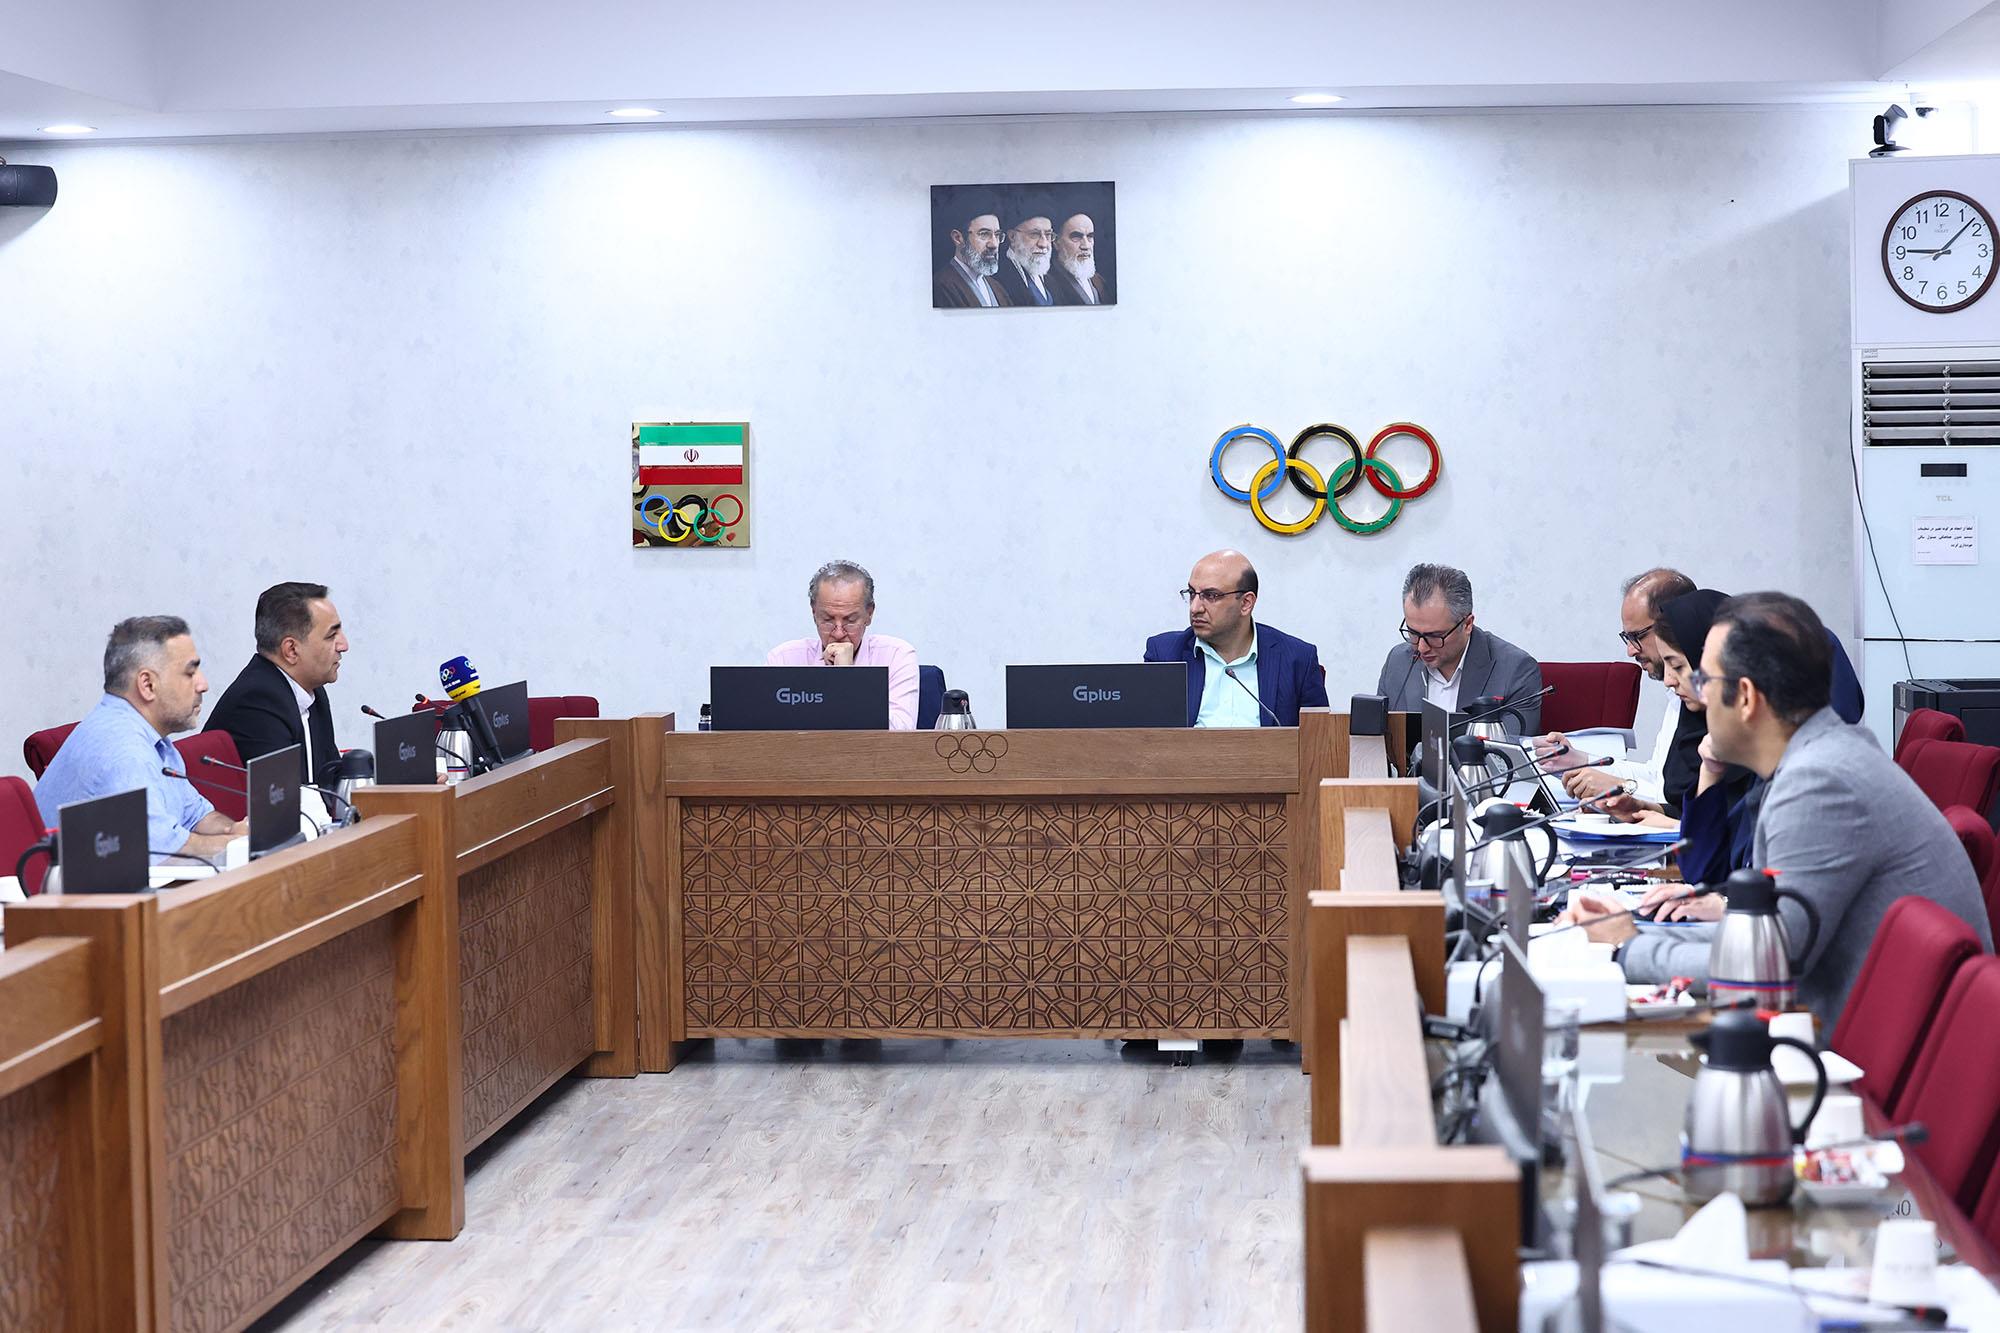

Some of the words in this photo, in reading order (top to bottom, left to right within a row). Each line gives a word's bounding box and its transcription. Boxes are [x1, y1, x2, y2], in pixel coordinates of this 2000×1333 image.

[1916, 209, 1928, 224] 11
[1933, 203, 1949, 217] 12
[1959, 208, 1964, 222] 1
[1901, 226, 1917, 240] 10
[1972, 223, 1982, 237] 2
[1895, 246, 1906, 260] 9
[1977, 243, 1988, 258] 3
[1903, 266, 1914, 280] 8
[1971, 265, 1983, 279] 4
[1918, 280, 1928, 295] 7
[1936, 285, 1948, 300] 6
[1957, 281, 1967, 295] 5
[776, 687, 823, 705] Gplus
[1072, 685, 1121, 703] Gplus
[493, 711, 510, 728] Gplus
[399, 741, 416, 761] Gplus
